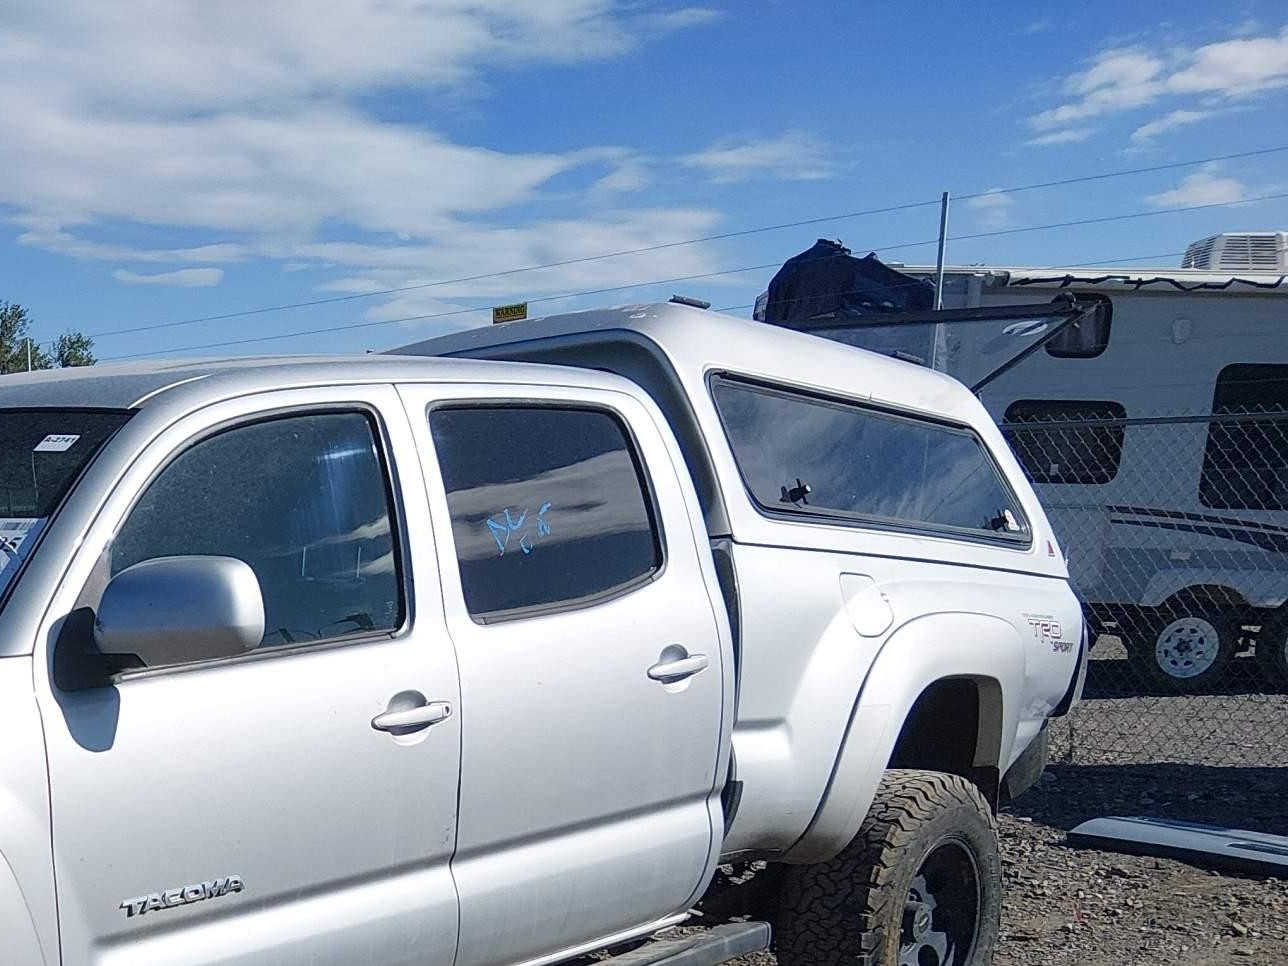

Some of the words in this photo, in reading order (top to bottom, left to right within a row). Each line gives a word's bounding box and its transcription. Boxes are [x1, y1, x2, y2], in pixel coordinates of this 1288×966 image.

[1027, 618, 1062, 643] TRD
[1052, 641, 1073, 653] SPORT
[119, 874, 245, 919] TACOMA
